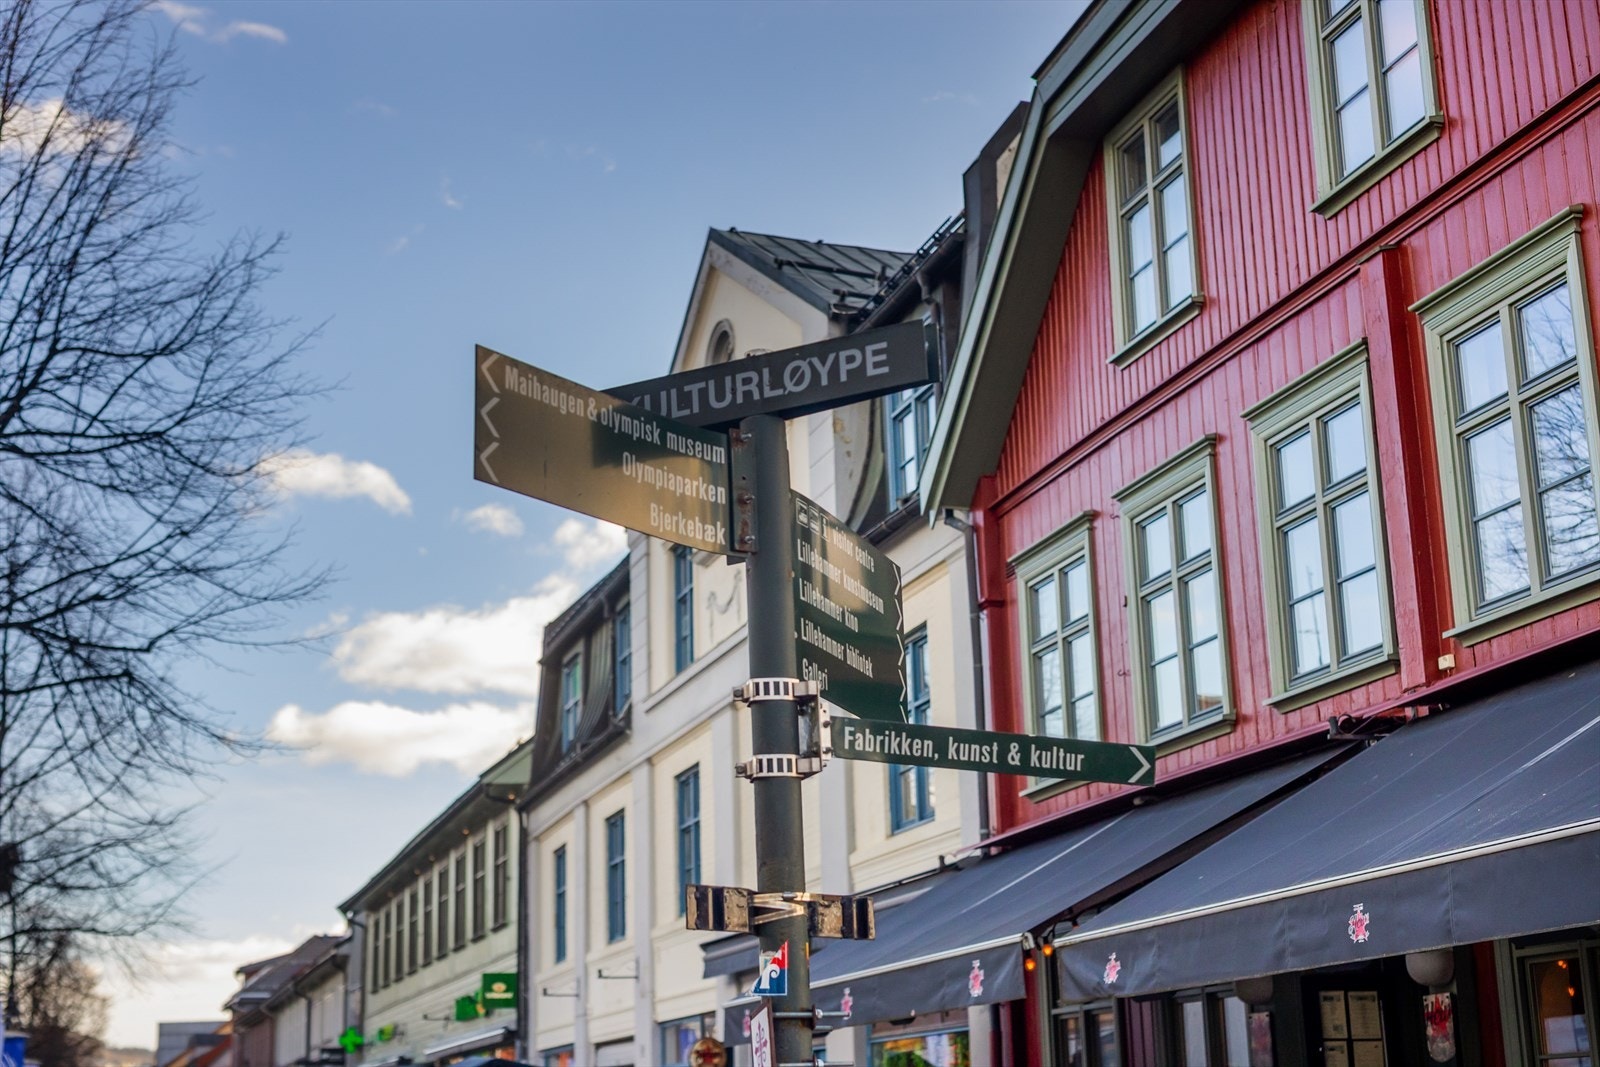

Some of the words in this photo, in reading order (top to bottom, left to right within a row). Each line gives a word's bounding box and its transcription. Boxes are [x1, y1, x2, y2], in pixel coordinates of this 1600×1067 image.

[630, 341, 889, 419] ULTURLØYPE
[504, 364, 585, 417] Maihaugen
[587, 397, 598, 422] &
[600, 404, 661, 446] olympisk
[666, 430, 726, 464] museum
[622, 451, 726, 505] Olympiaparken
[650, 502, 726, 545] Bjerkebæk
[832, 526, 853, 557] visitor
[855, 545, 875, 573] centre
[797, 538, 842, 585] Lillehammer
[843, 567, 885, 615] kunstmuseum
[799, 577, 843, 623] Lillehammer
[844, 605, 859, 633] kino
[800, 617, 845, 661] Lillehammer
[845, 643, 874, 679] bibliotek
[802, 657, 829, 691] Galleri
[843, 726, 939, 761] Fabrikken,
[948, 736, 999, 764] kunst
[1007, 742, 1021, 767] &
[1030, 744, 1085, 772] kultur
